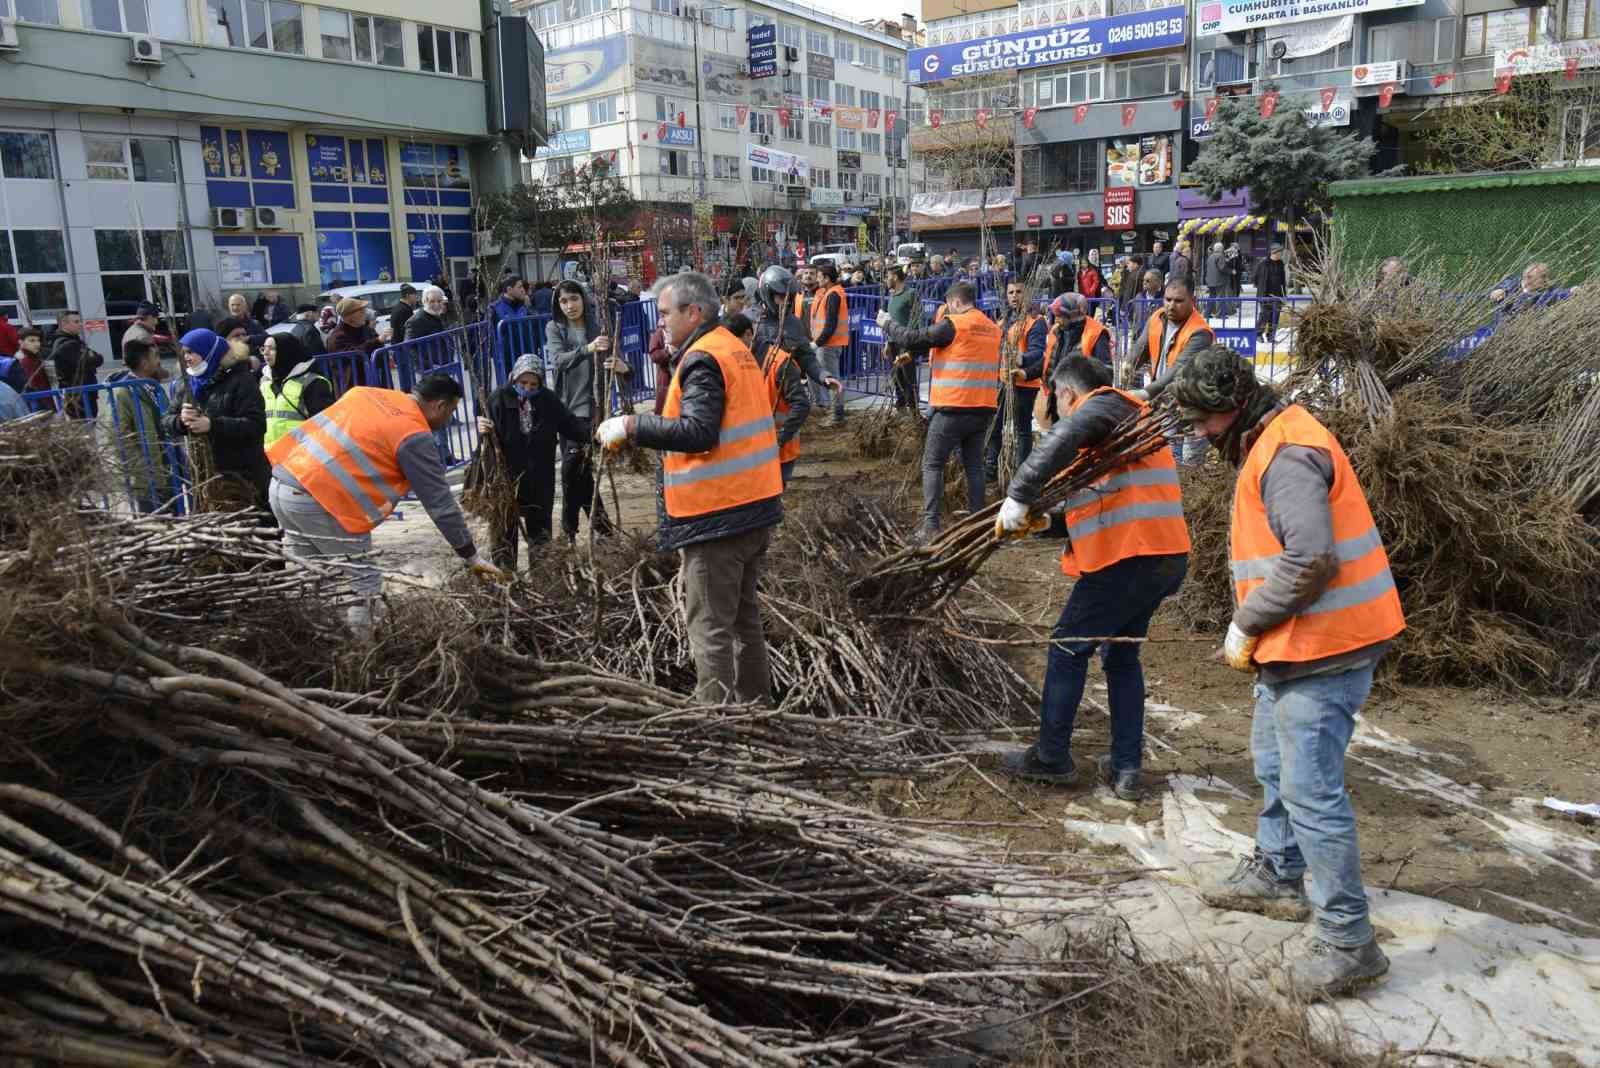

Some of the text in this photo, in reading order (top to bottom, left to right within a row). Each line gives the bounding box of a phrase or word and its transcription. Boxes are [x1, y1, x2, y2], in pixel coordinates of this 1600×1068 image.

[1108, 17, 1183, 43] 0246 500 52 53
[1202, 21, 1220, 31] CHP
[962, 24, 1091, 60] GÜNDÜZ
[1034, 43, 1103, 63] KURSU
[1107, 204, 1131, 226] SOS
